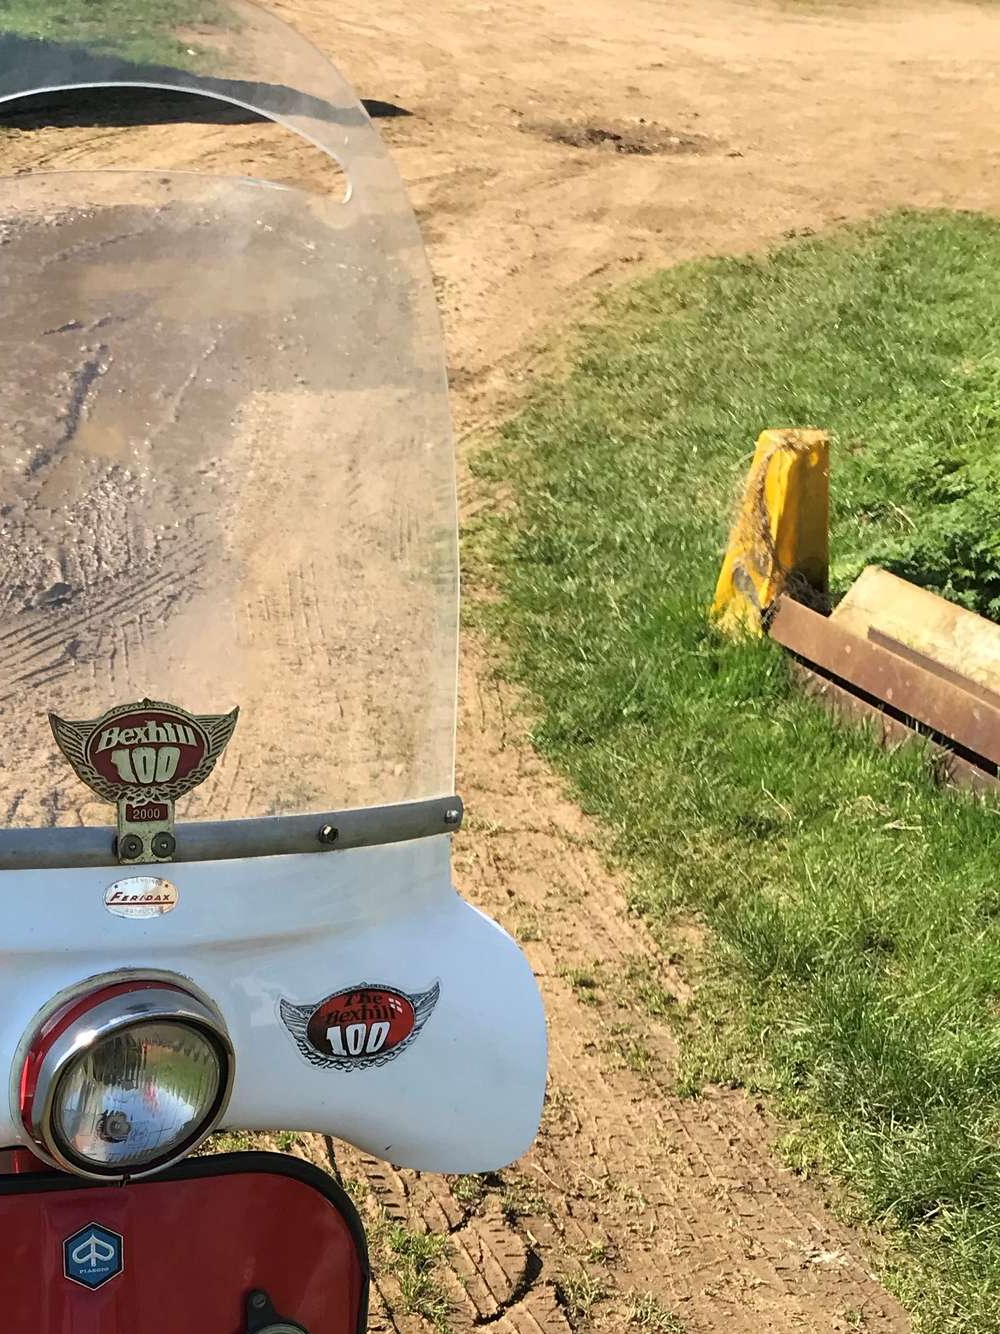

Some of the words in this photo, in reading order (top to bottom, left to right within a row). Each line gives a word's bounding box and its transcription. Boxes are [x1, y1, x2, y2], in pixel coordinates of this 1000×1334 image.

[96, 720, 198, 753] Bexhill
[111, 746, 181, 784] 100
[132, 808, 160, 820] 2000
[326, 1021, 391, 1057] 100
